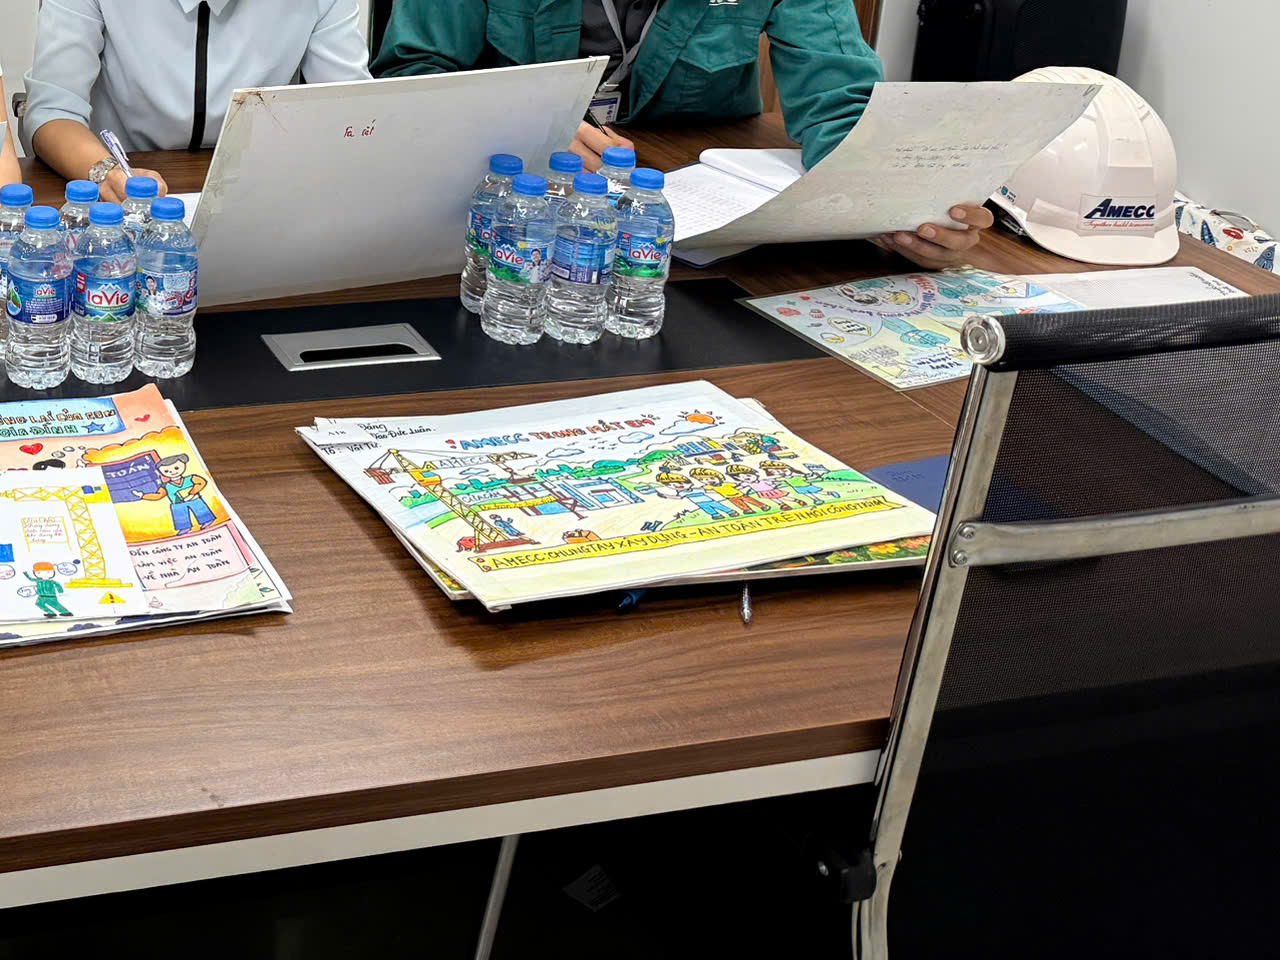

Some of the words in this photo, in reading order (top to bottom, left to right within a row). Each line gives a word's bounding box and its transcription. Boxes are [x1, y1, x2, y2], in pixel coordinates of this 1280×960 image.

[495, 249, 524, 265] laVie
[629, 246, 661, 260] laVie
[87, 289, 130, 306] laVie
[460, 433, 530, 450] AMECC
[528, 428, 586, 440] TRONG
[106, 462, 150, 478] TOÁN
[697, 524, 720, 536] AN
